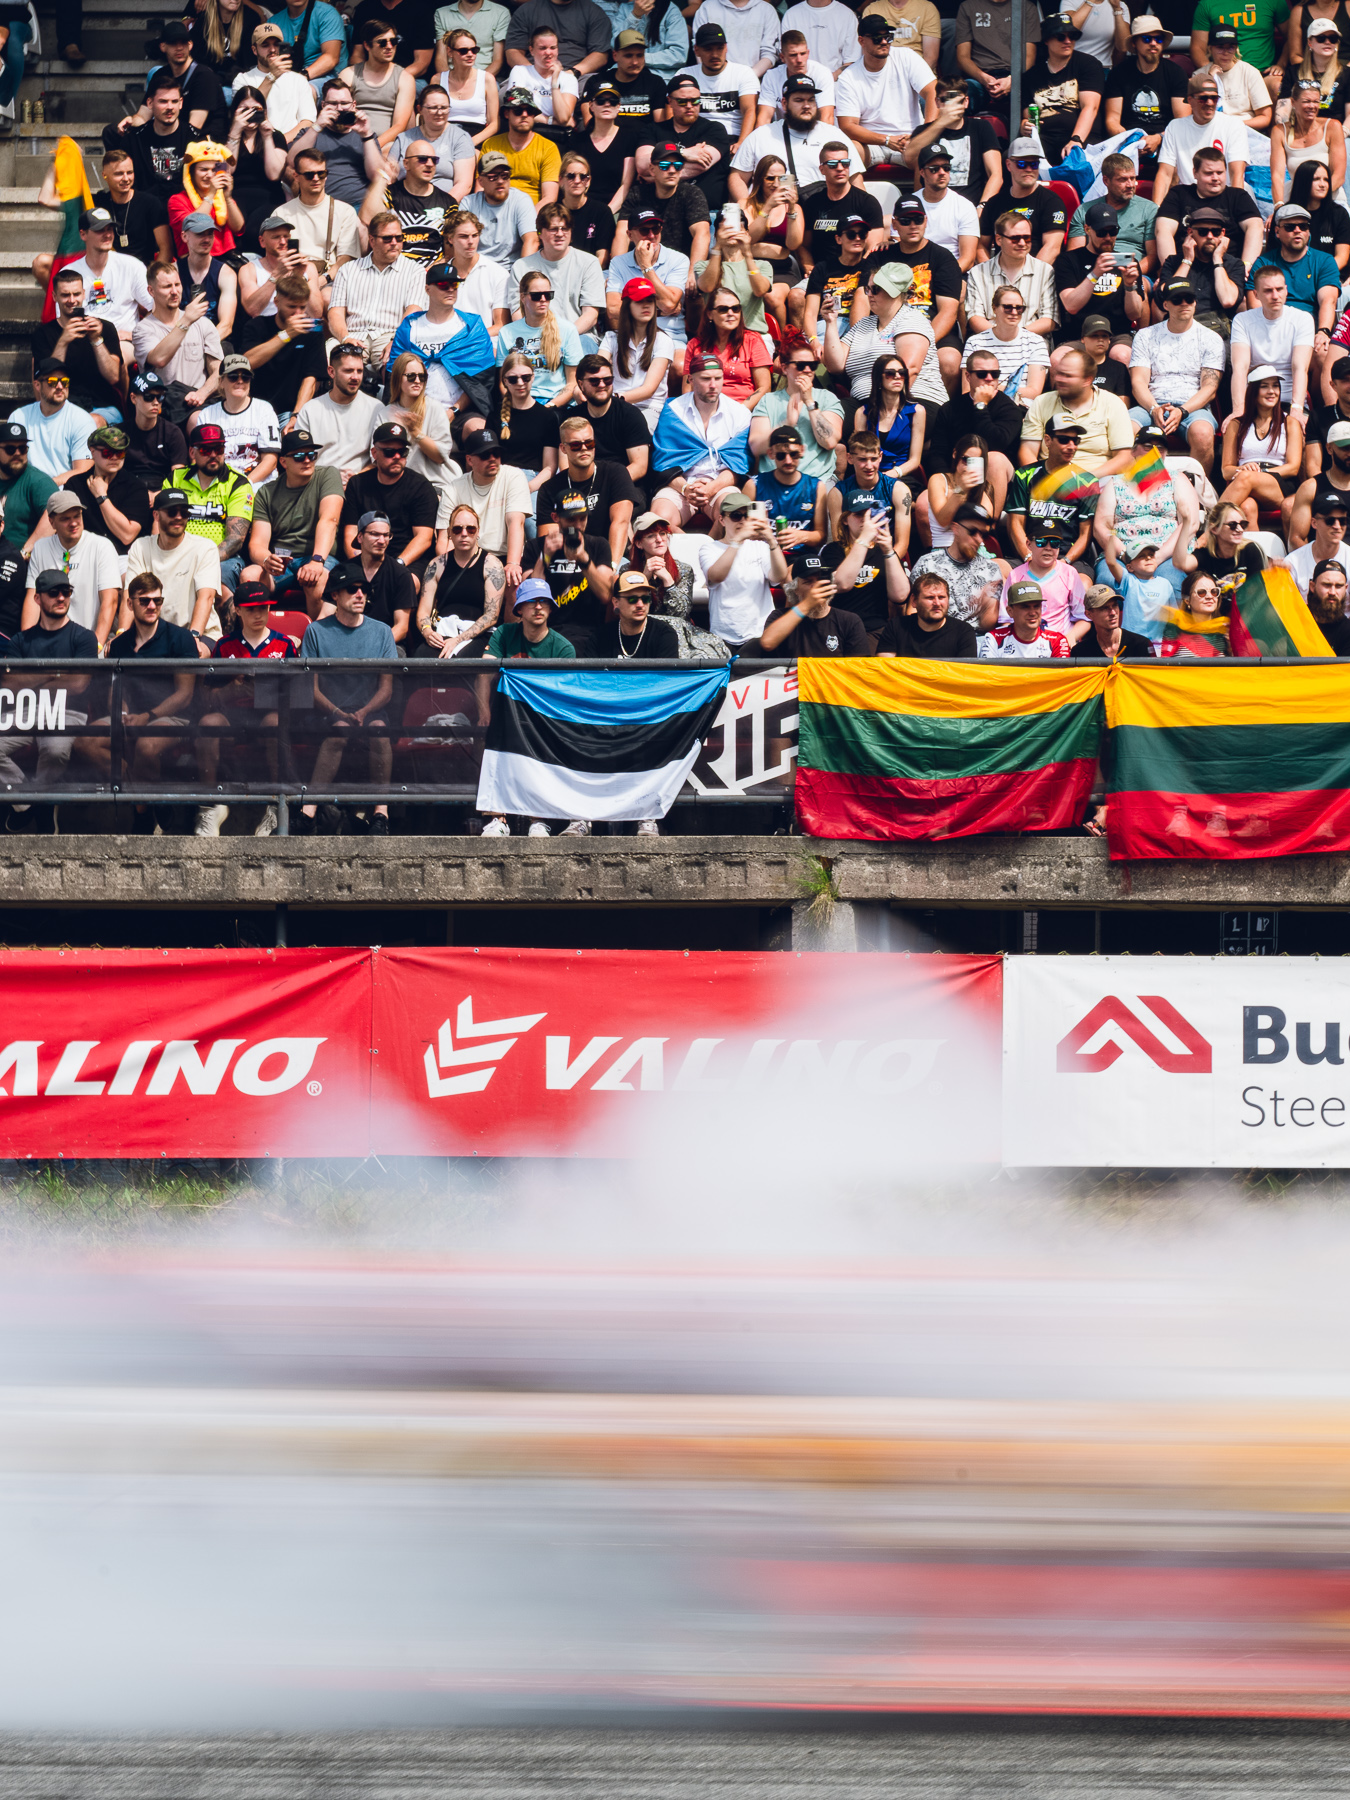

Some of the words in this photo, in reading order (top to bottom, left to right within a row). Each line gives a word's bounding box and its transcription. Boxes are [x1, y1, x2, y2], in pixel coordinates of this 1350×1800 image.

[976, 12, 991, 27] 23
[619, 104, 650, 113] STERS
[0, 688, 67, 731] COM
[546, 1036, 949, 1092] VALINO
